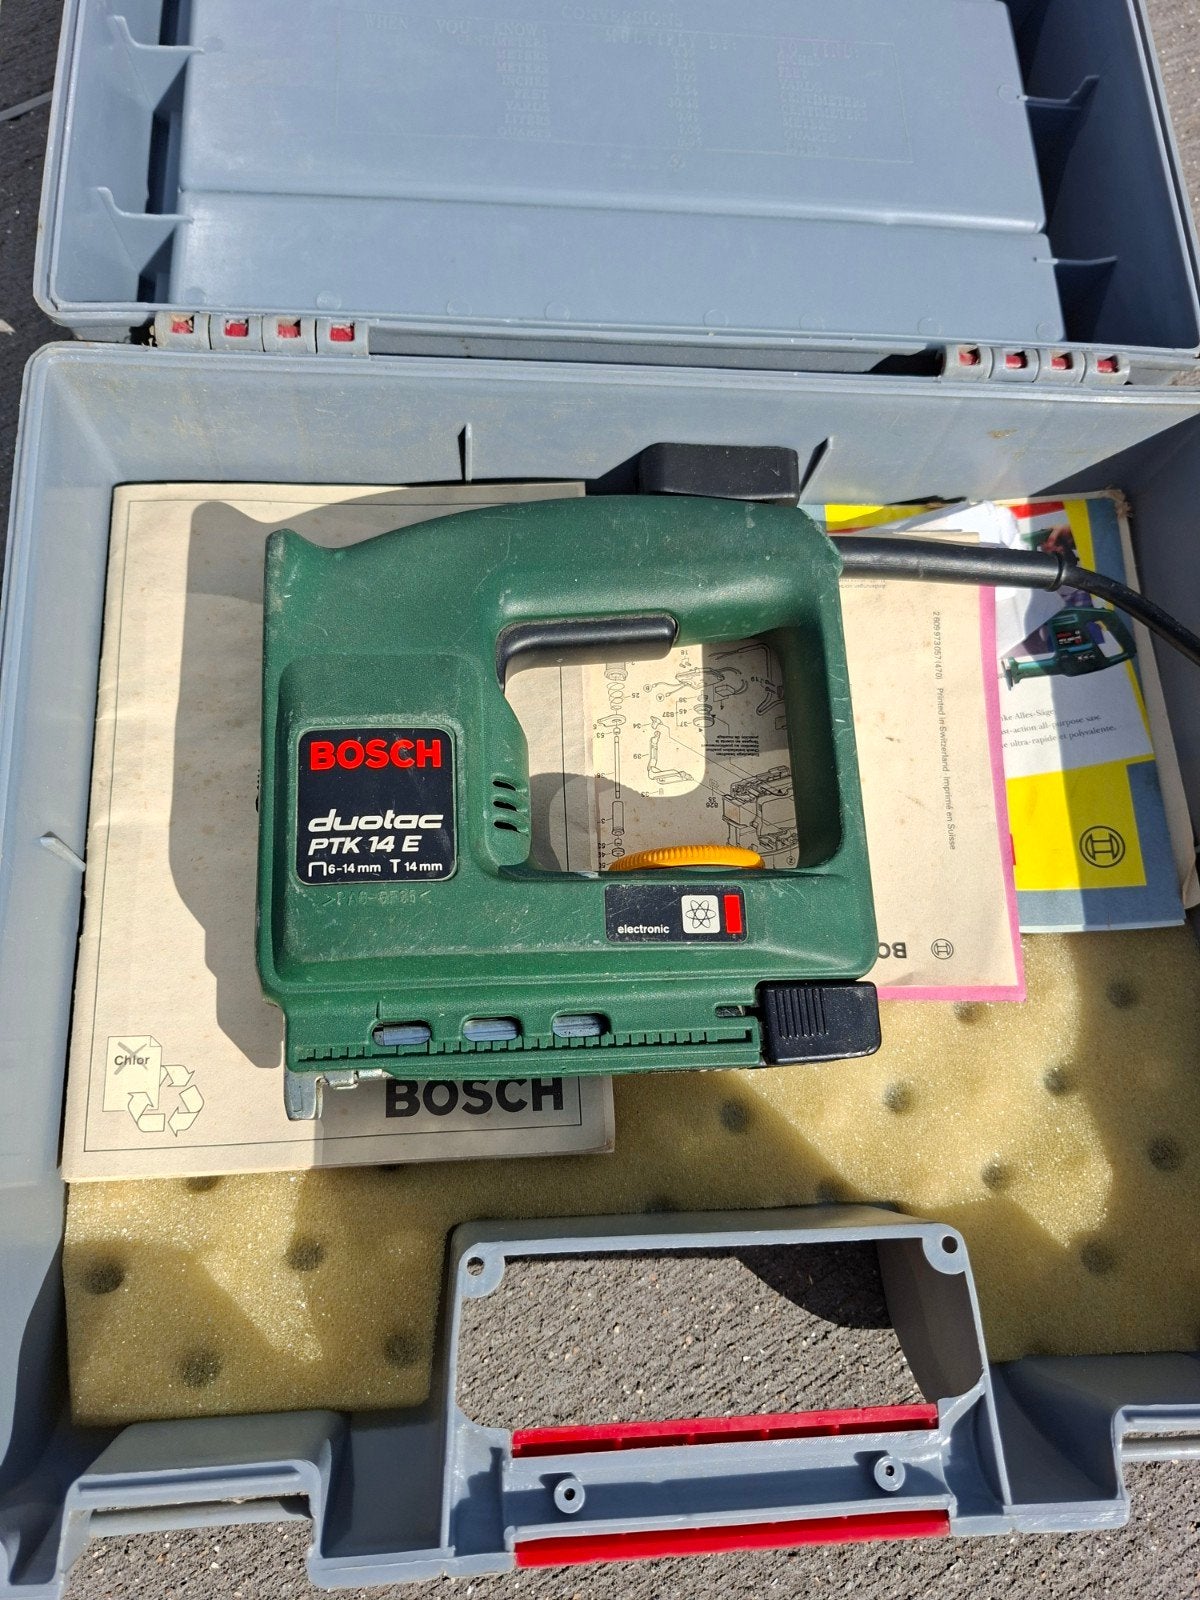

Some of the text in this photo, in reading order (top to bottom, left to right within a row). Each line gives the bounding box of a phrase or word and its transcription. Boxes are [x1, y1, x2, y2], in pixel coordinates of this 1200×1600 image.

[364, 13, 409, 30] WHEN
[435, 19, 471, 35] YOU
[561, 5, 684, 27] CONVERSIONS
[936, 687, 947, 716] Printed
[310, 738, 442, 771] BOSCH
[939, 726, 951, 772] Switzerland
[942, 776, 954, 810] Imprimé
[307, 808, 444, 833] duotac
[308, 835, 422, 856] PTK 14 E
[947, 824, 956, 850] Suisse
[328, 862, 443, 875] 6-14 mm 14 mm
[617, 923, 670, 934] electronic
[113, 1053, 151, 1067] Chlor
[385, 1077, 565, 1119] BOSCH
